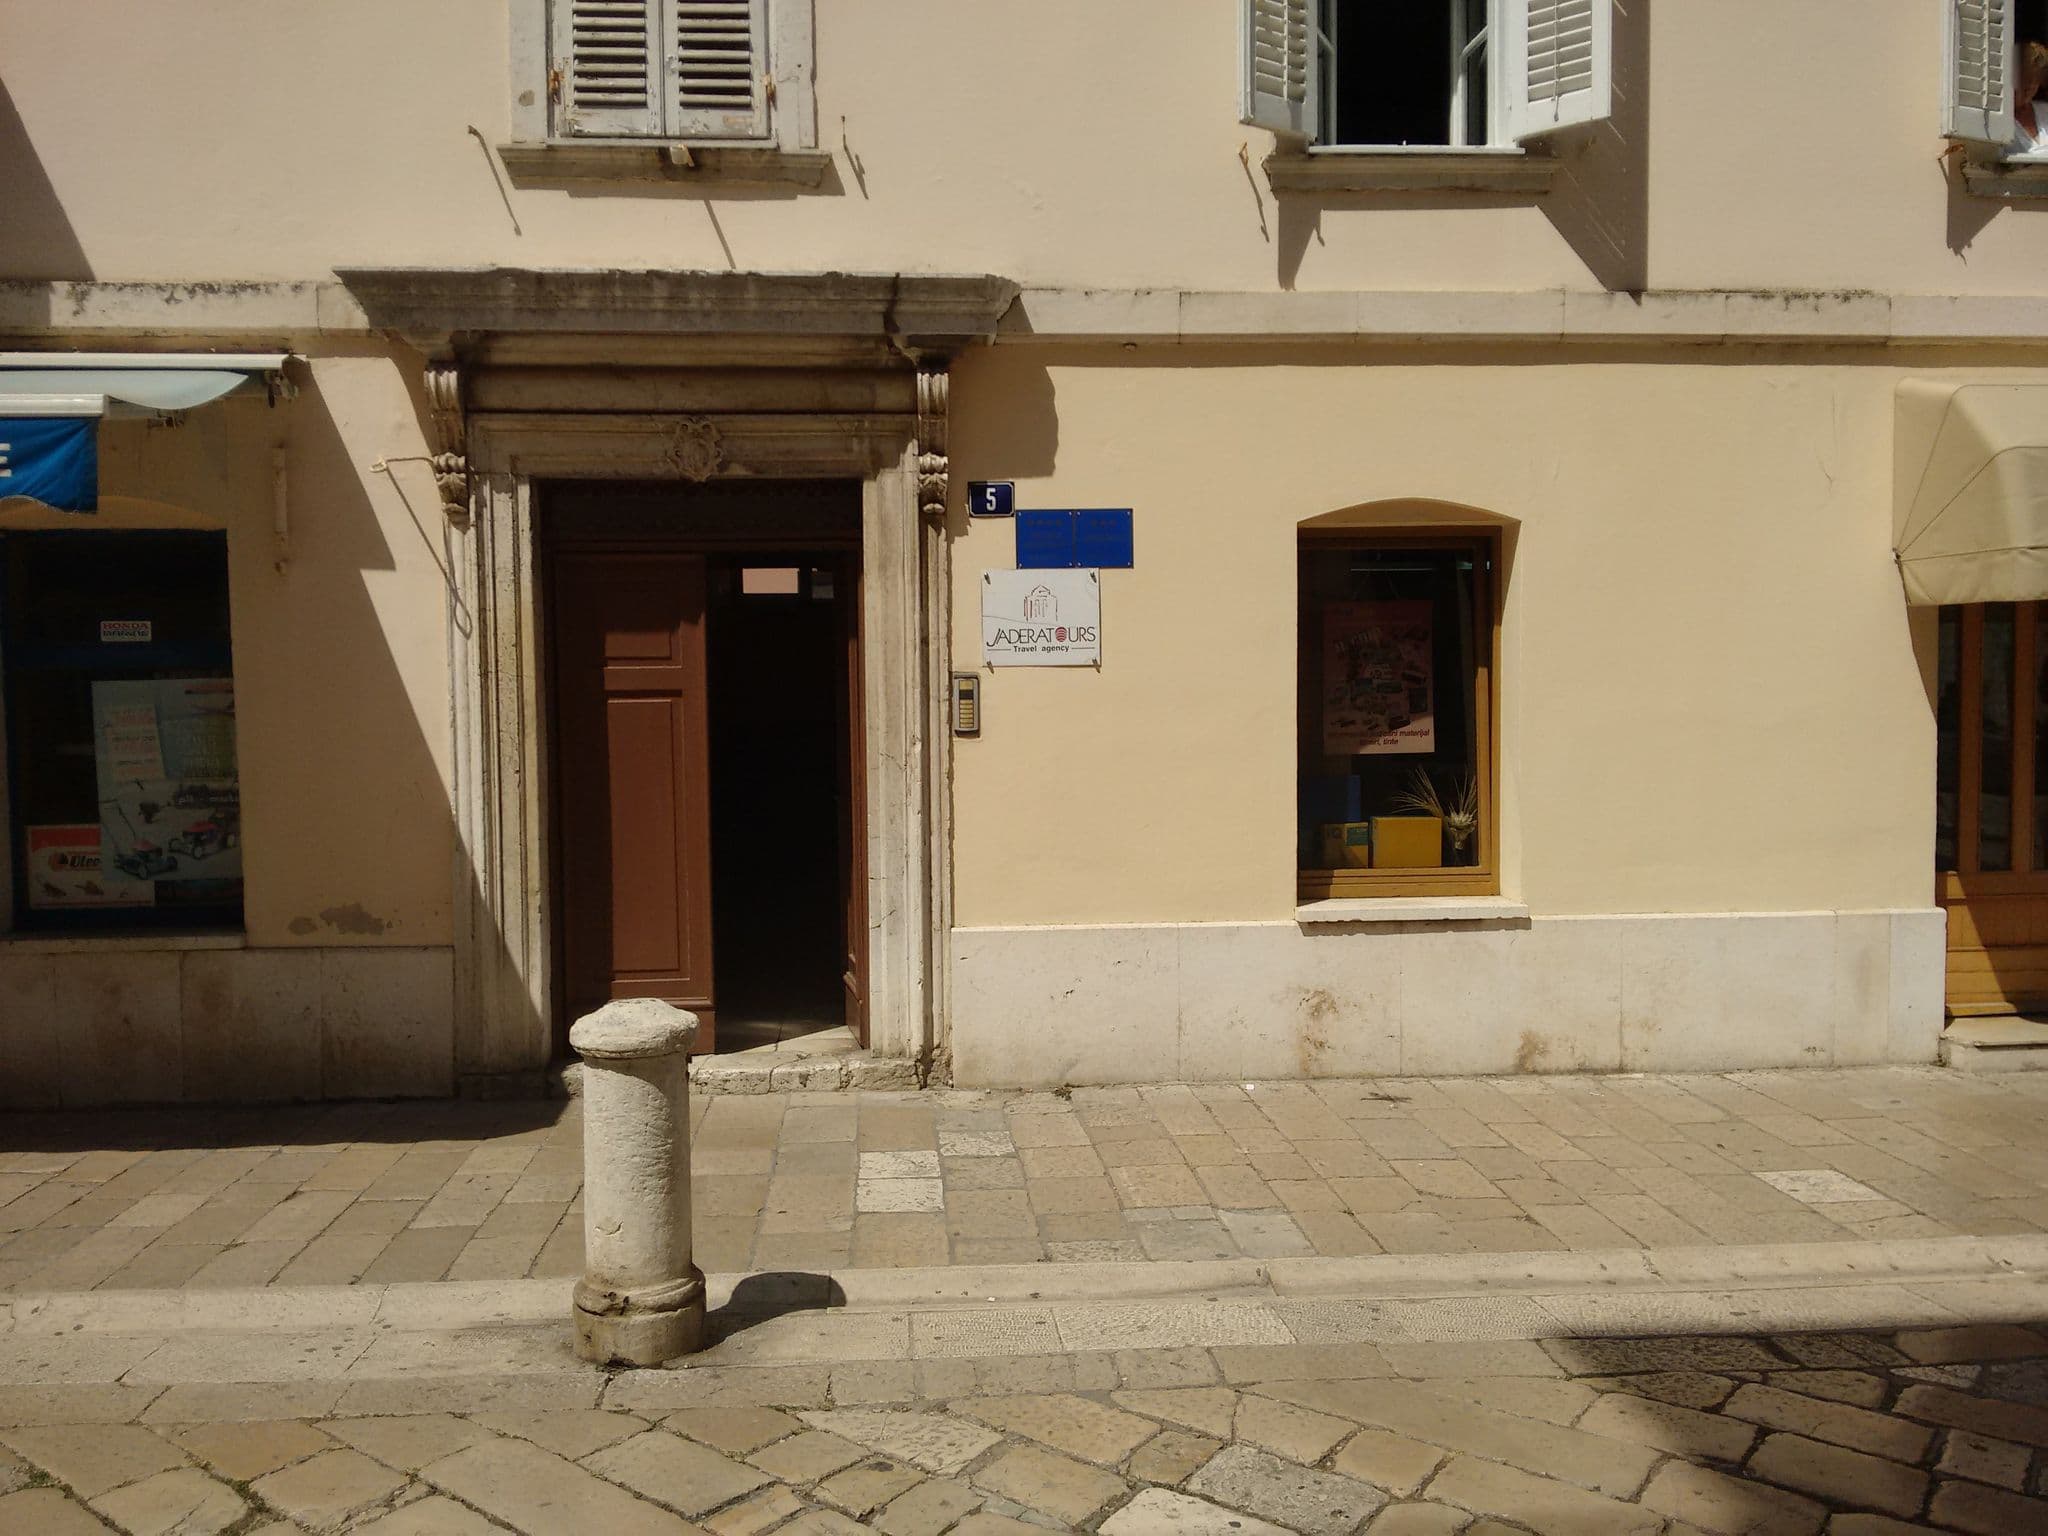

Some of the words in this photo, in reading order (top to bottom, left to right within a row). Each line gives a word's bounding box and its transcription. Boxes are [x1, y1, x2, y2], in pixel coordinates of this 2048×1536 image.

[985, 487, 996, 511] 5
[986, 626, 1096, 646] JADERATOURS
[1013, 645, 1037, 653] Travel
[1041, 645, 1070, 653] agency
